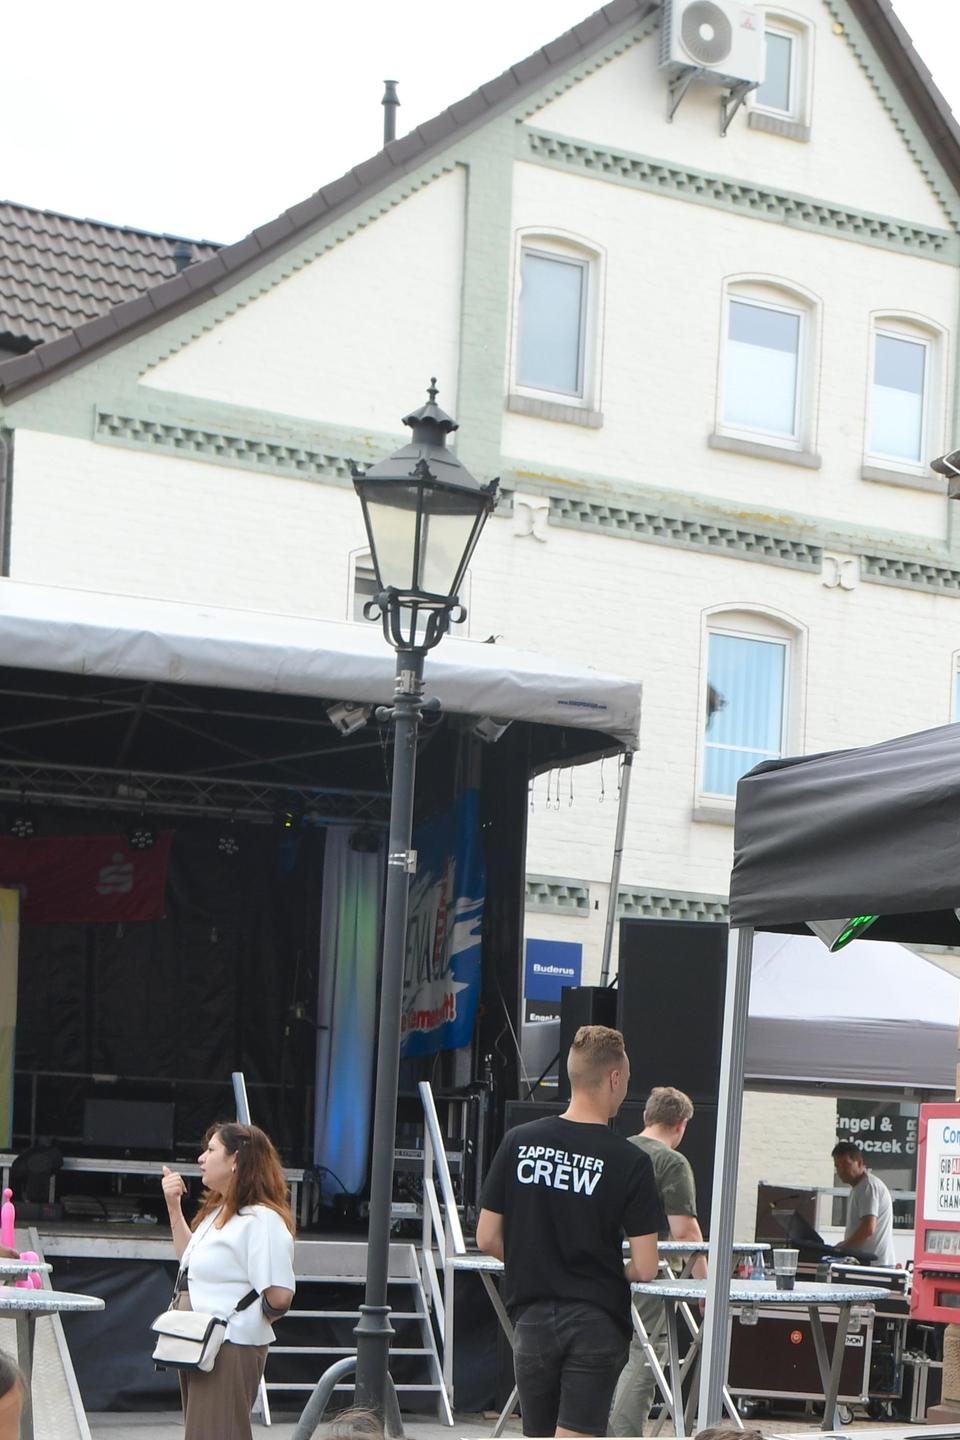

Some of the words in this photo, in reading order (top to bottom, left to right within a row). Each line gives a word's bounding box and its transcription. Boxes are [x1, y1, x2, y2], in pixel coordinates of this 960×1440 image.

[533, 964, 575, 975] Buderus
[880, 1117, 893, 1132] &
[518, 1145, 604, 1173] ZAPPELTIER
[940, 1158, 951, 1174] GIB
[517, 1159, 602, 1195] CREW
